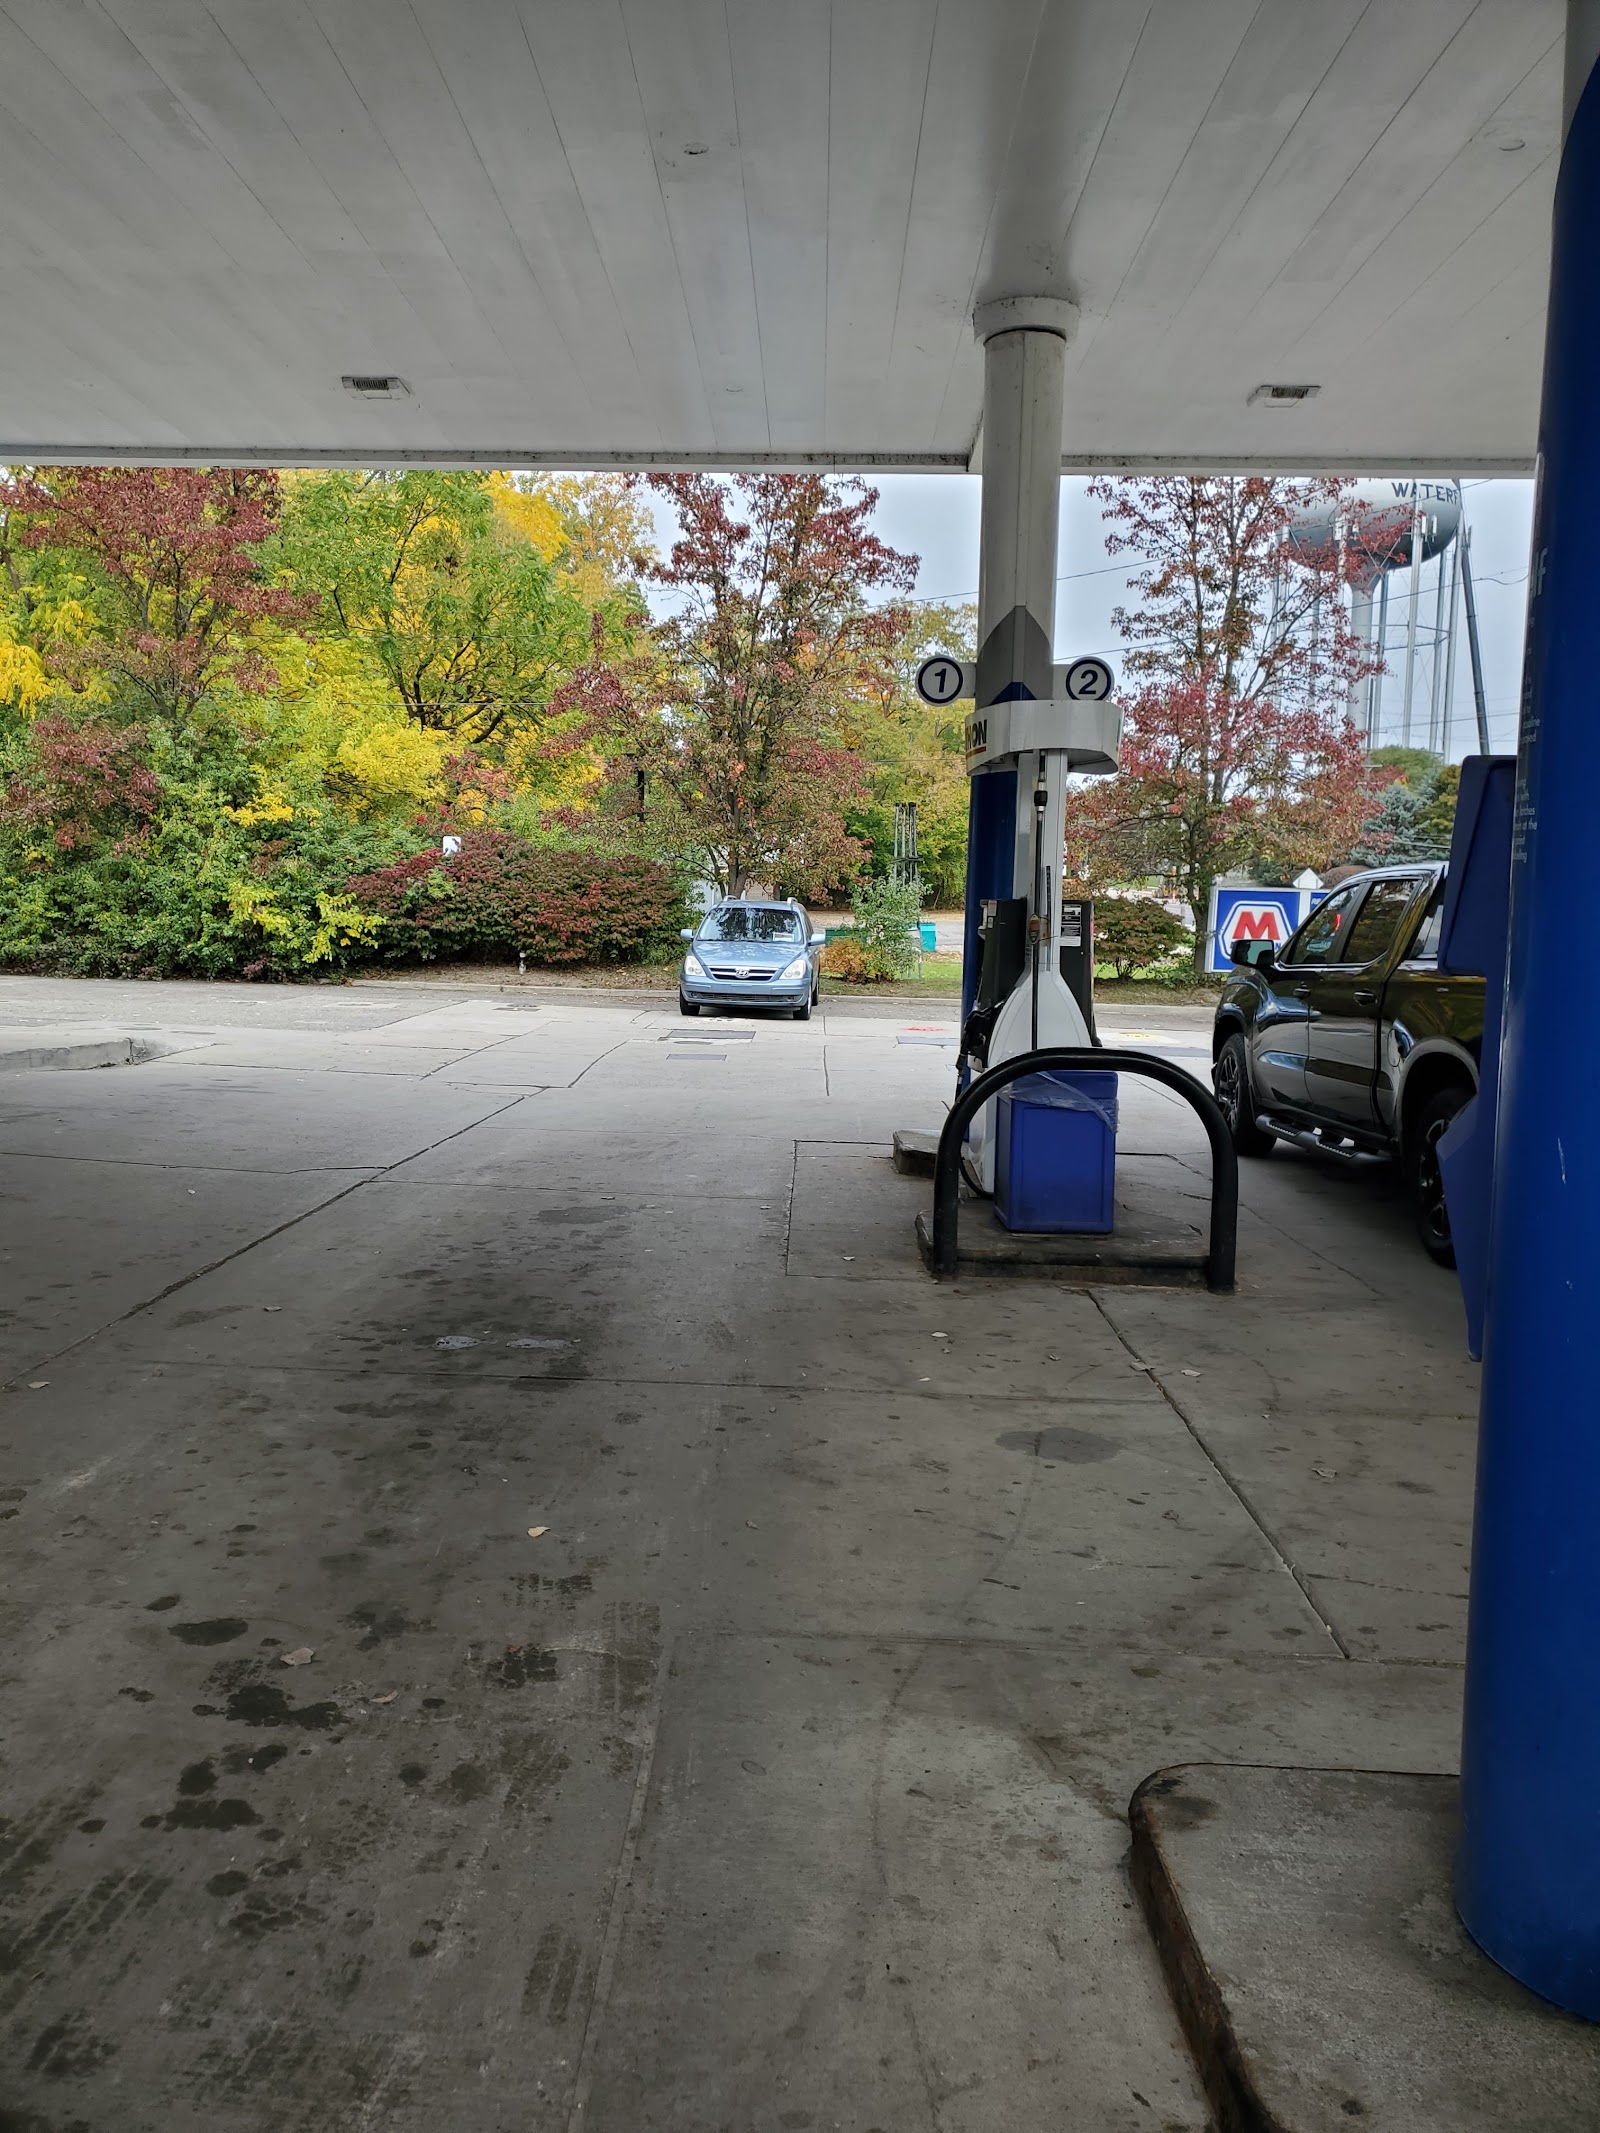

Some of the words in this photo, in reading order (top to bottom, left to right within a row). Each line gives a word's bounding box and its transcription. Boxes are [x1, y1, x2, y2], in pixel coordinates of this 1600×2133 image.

[934, 668, 947, 693] 1
[1078, 669, 1099, 695] 2
[1232, 912, 1280, 940] M
